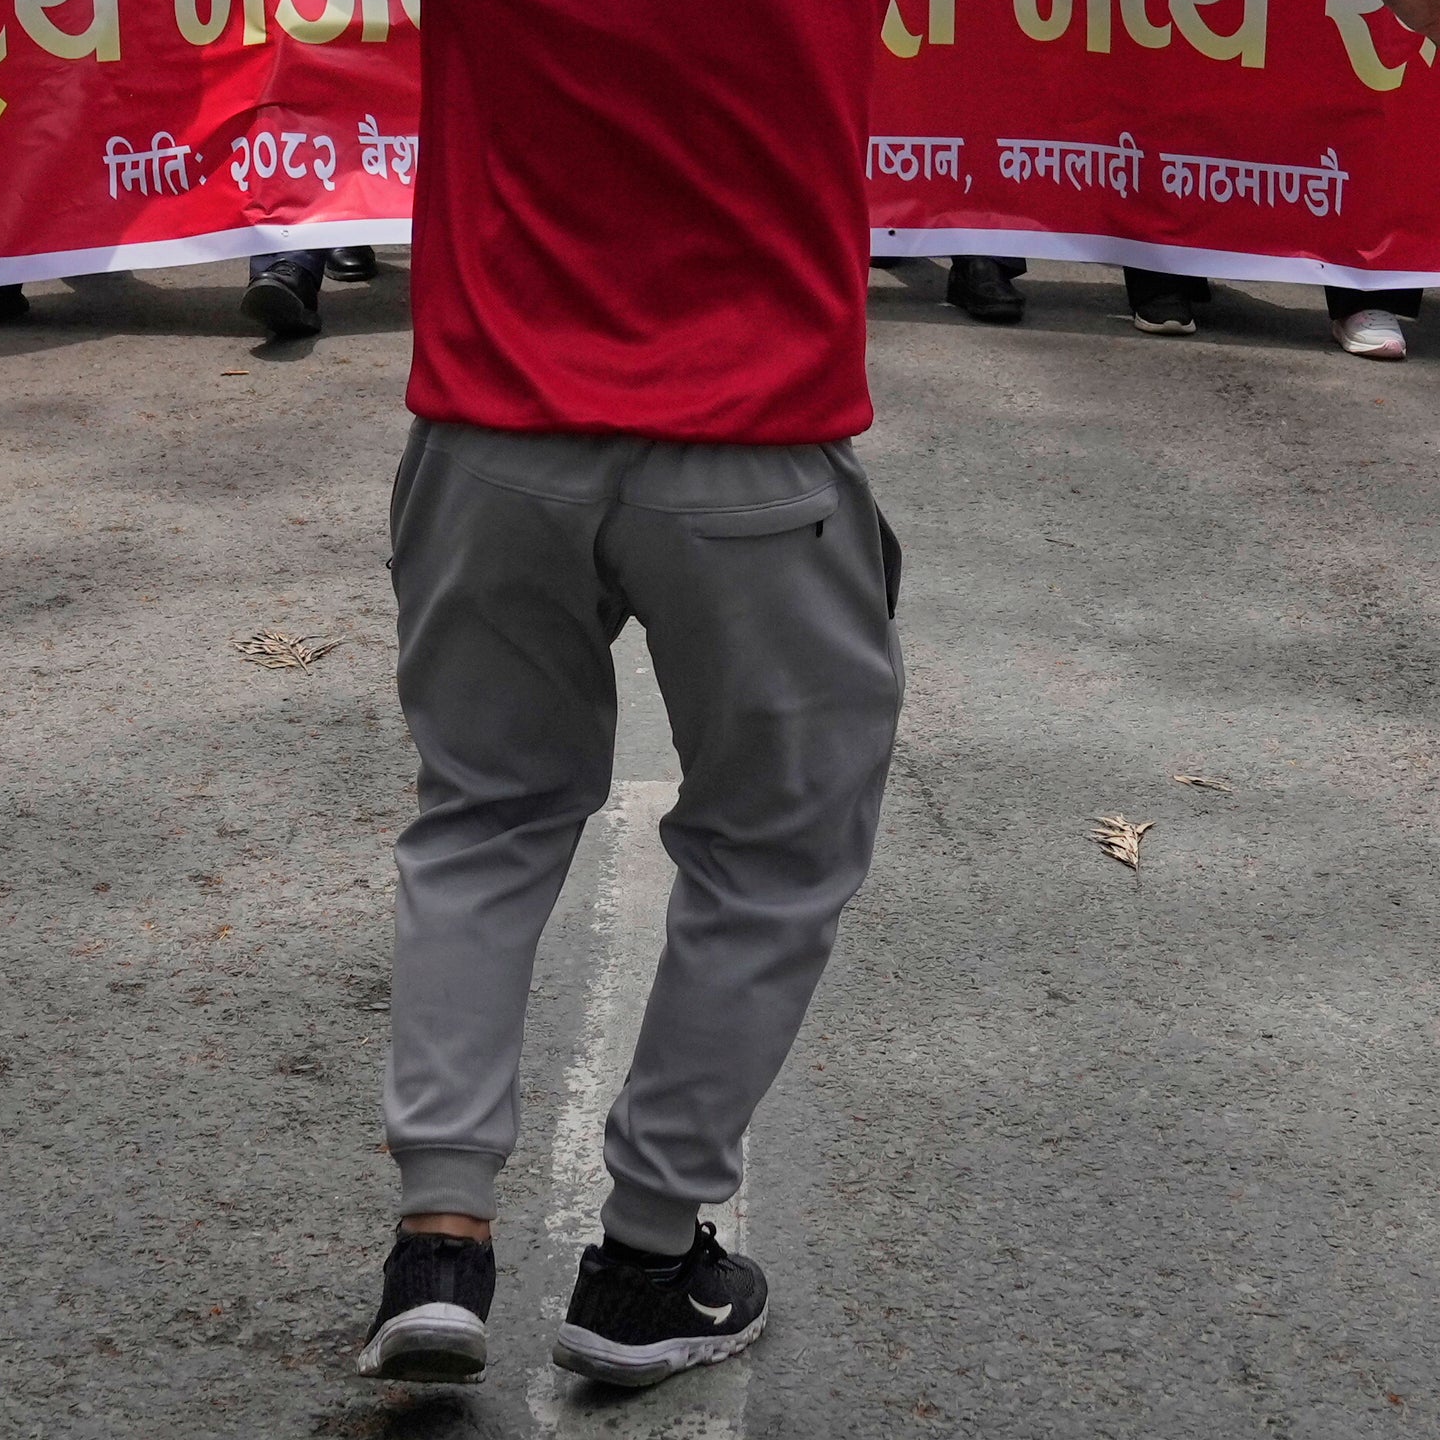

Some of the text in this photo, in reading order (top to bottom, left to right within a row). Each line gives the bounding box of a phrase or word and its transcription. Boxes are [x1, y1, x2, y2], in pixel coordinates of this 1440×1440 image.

[230, 130, 338, 192] २०८२
[997, 132, 1144, 198] कमलादी
[1159, 147, 1350, 217] काठमाण्डौ
